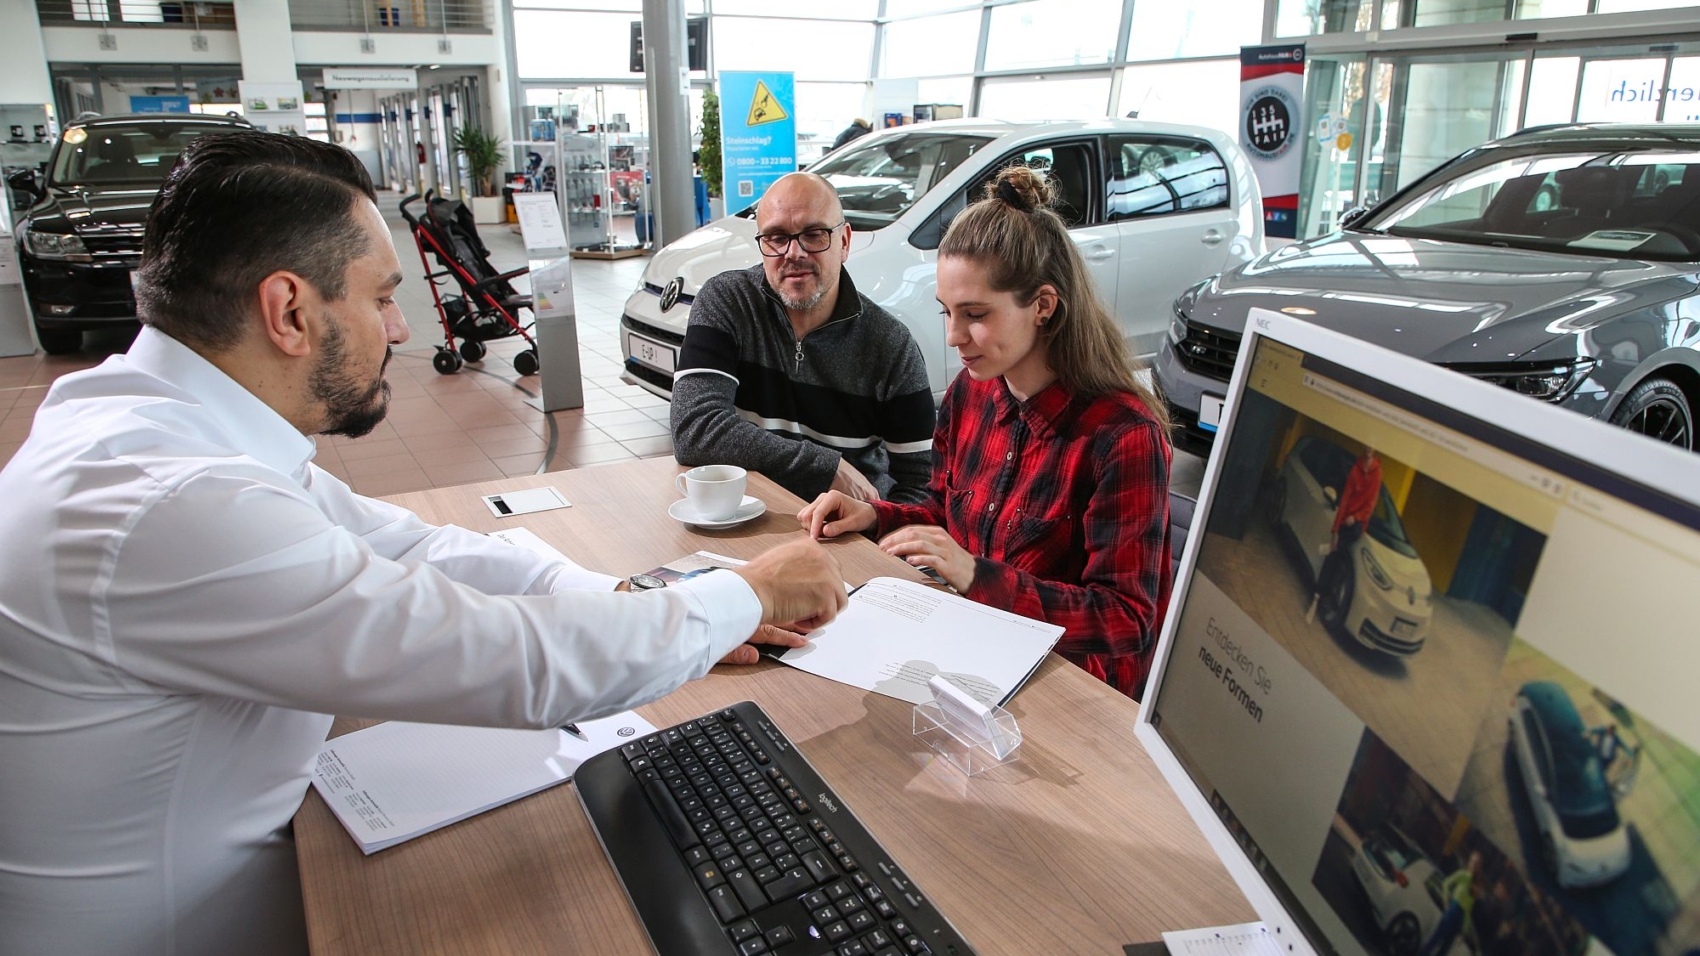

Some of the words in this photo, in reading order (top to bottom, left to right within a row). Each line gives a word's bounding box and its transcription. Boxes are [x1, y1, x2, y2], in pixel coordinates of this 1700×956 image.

[1261, 107, 1267, 117] 3
[1269, 104, 1275, 115] 5
[725, 135, 772, 146] Steinschlag?
[1255, 130, 1285, 145] FAIR
[737, 158, 756, 166] 0800
[760, 157, 769, 165] 33
[770, 157, 779, 165] 22
[780, 156, 793, 165] 800
[1256, 317, 1271, 330] NEC
[1206, 616, 1255, 677] Entdecken
[1254, 665, 1272, 695] Sie
[1198, 645, 1222, 679] neue
[1222, 667, 1263, 723] Formen
[818, 792, 838, 813] logitech
